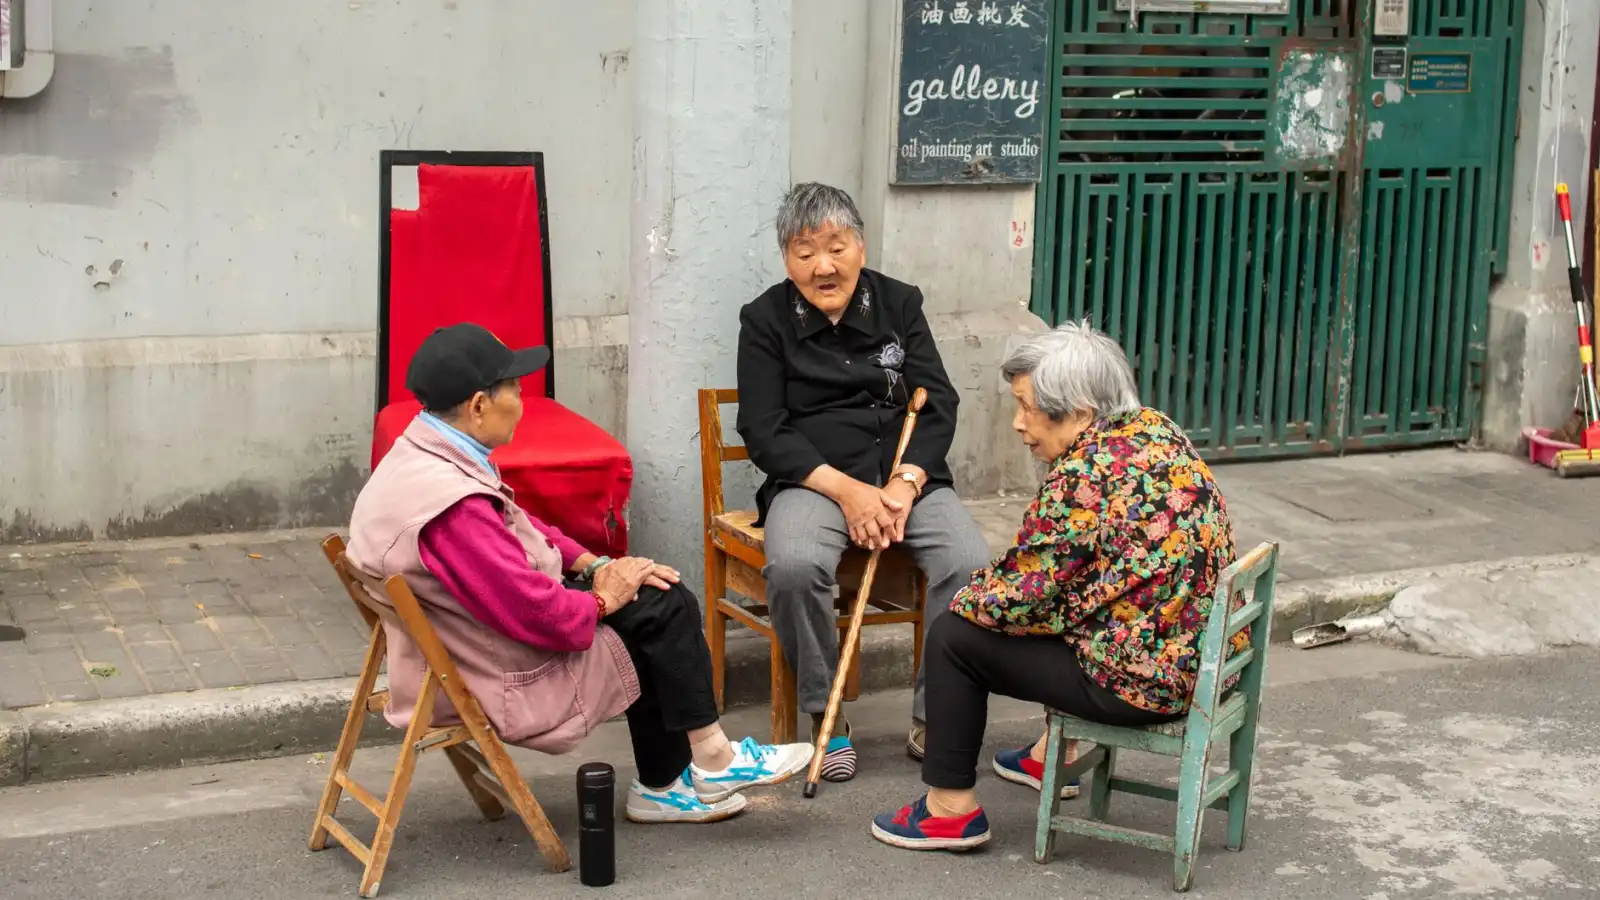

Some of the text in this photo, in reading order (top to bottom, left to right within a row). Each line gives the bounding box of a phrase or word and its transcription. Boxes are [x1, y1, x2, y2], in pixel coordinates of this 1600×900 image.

[921, 1, 1030, 28] 油画批发
[903, 64, 1039, 118] gallery
[901, 138, 1038, 162] oil painting art studio
